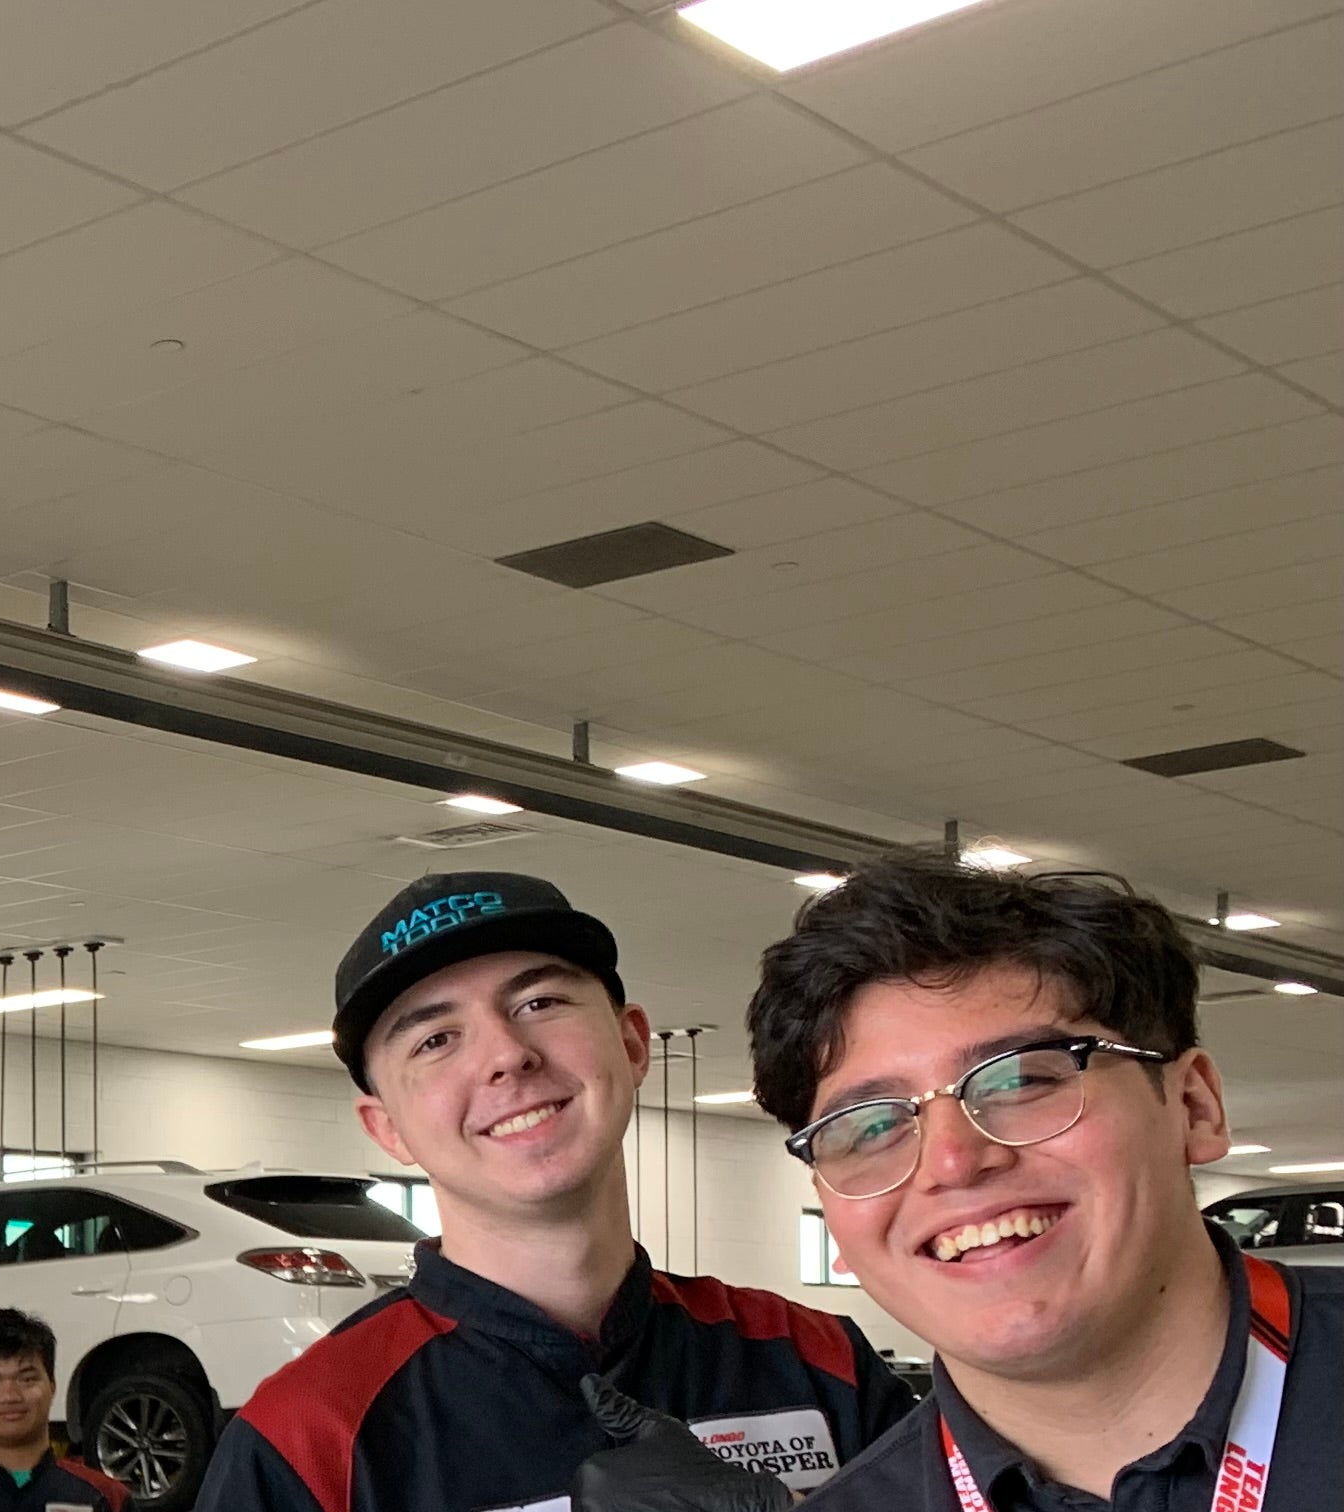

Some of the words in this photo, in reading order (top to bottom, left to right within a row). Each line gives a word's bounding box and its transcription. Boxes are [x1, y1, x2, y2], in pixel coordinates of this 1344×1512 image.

[381, 891, 502, 953] MATCO
[711, 1440, 787, 1460] OYOTA
[789, 1435, 816, 1452] OF
